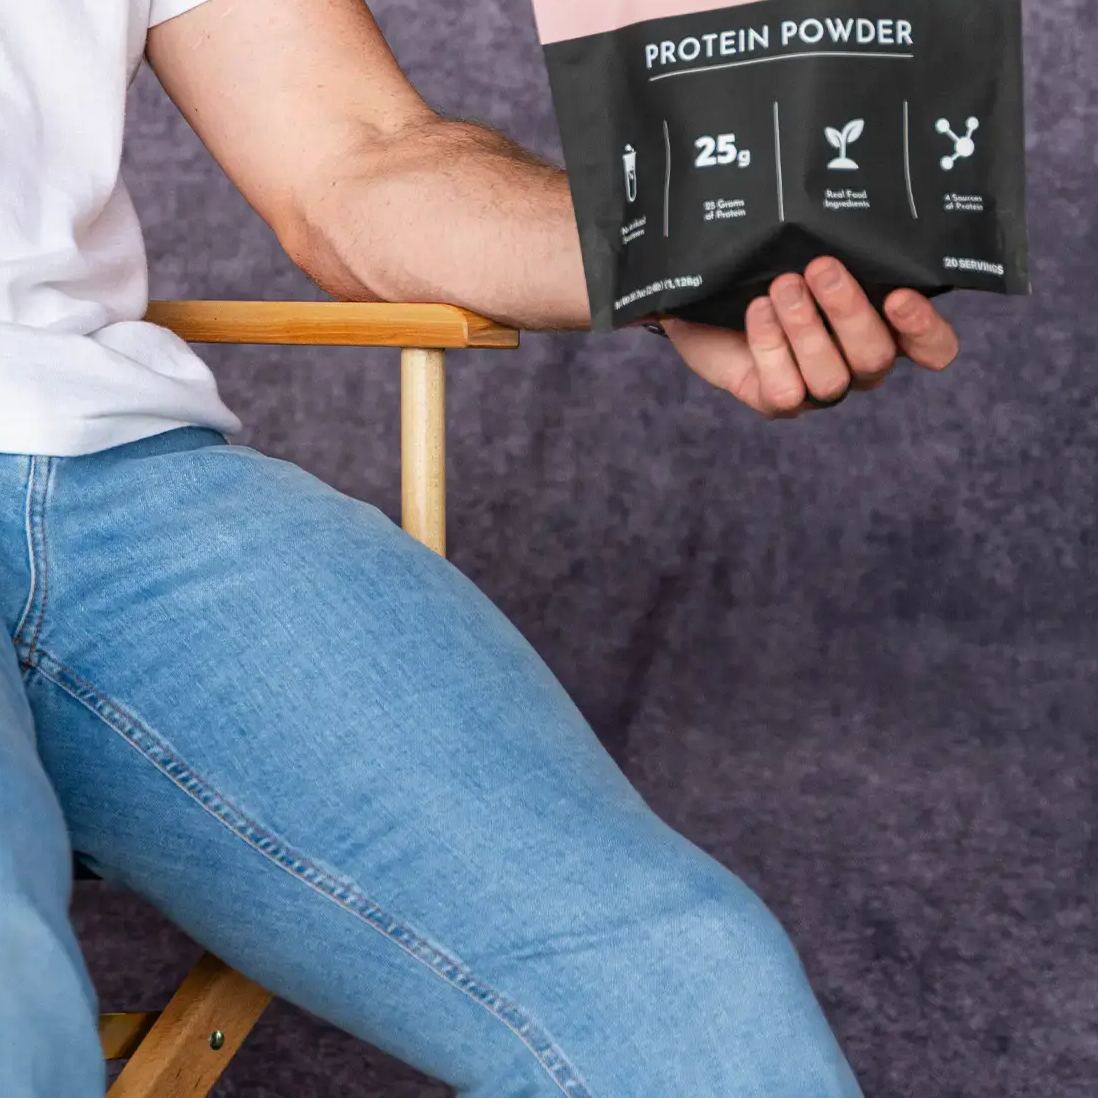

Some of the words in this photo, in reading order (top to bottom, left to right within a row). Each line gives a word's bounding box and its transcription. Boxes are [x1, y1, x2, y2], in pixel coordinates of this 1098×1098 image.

[644, 25, 769, 69] PROTEIN
[781, 18, 914, 46] POWDER
[694, 133, 751, 169] 25g
[826, 189, 846, 199] Real
[847, 189, 868, 199] Food
[952, 193, 983, 202] Sources
[717, 199, 745, 210] Grams
[824, 200, 870, 209] Ingredients
[956, 203, 983, 211] Protein
[705, 210, 714, 220] of
[716, 208, 746, 219] Protein
[944, 257, 958, 268] 20
[958, 258, 1004, 275] SERVINGS
